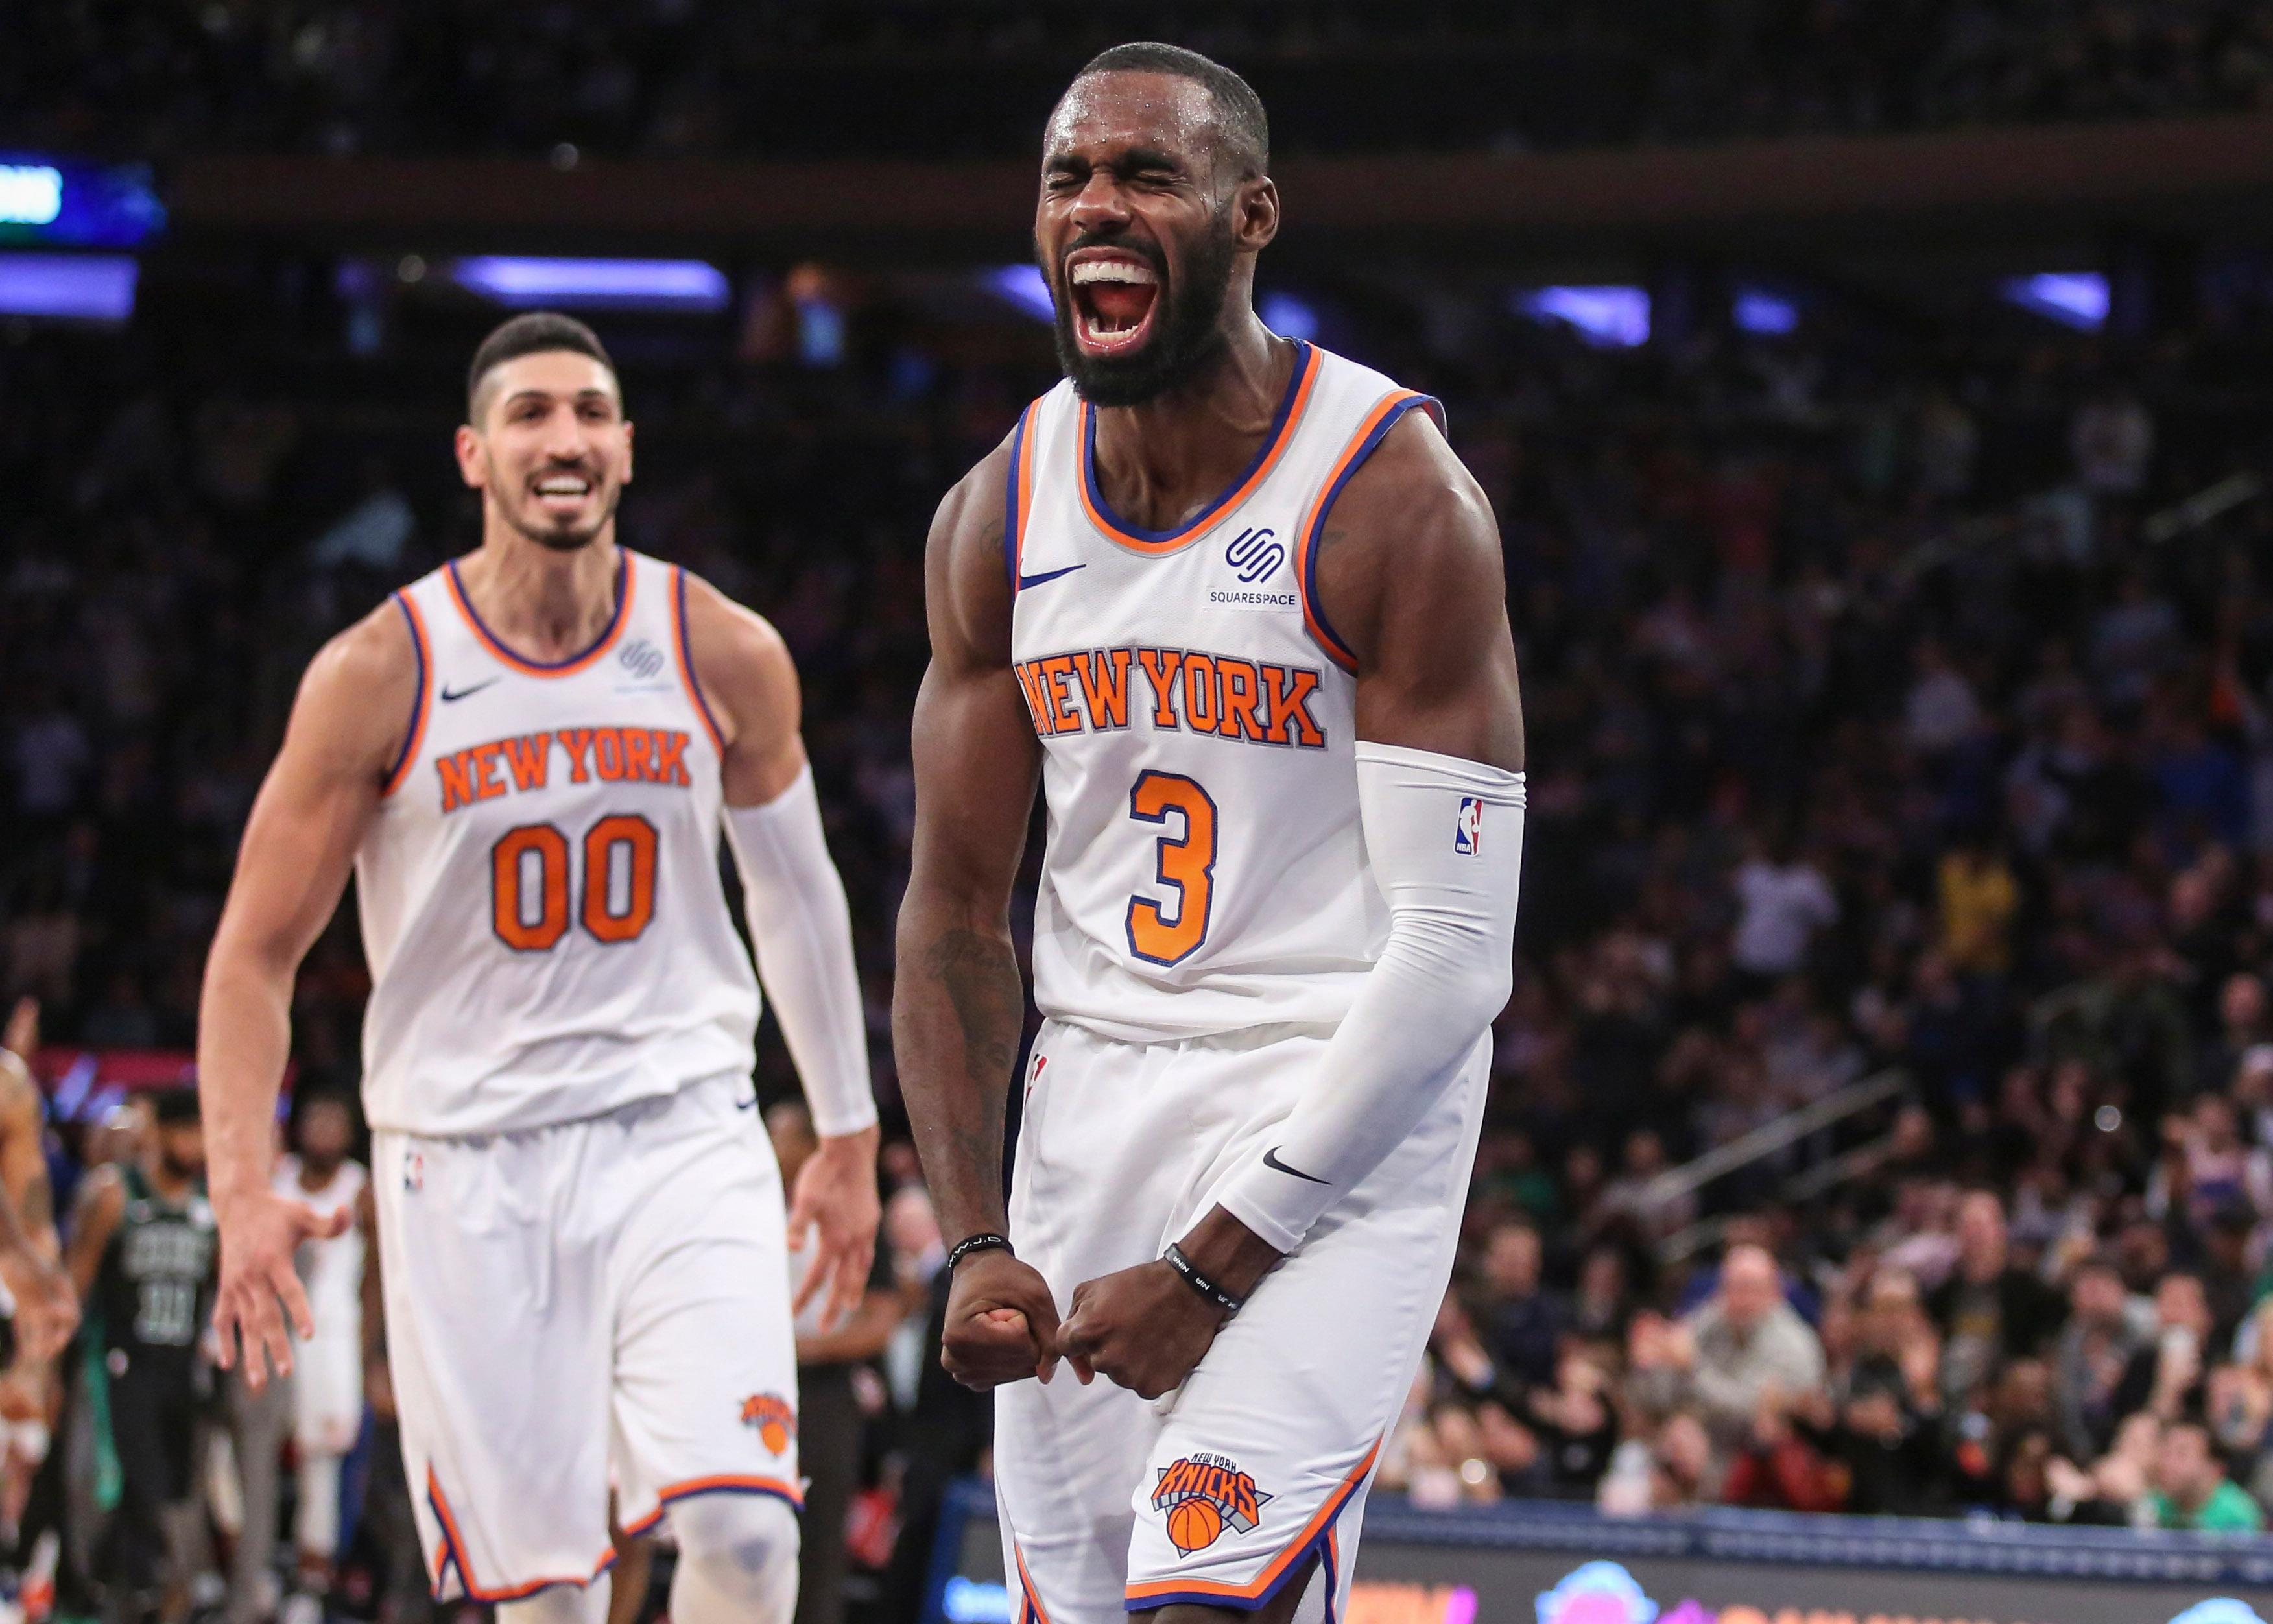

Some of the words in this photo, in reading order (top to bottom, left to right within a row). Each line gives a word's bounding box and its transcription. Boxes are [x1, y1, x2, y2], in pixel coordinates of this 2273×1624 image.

[1210, 591, 1296, 605] SQUARESPACE
[1014, 647, 1136, 737] NEW
[1137, 647, 1329, 751] YORK
[436, 732, 551, 815] NEW
[556, 726, 691, 787] YORK
[1125, 769, 1217, 968] 3
[1457, 842, 1471, 853] NBA
[490, 813, 659, 952] 00
[1172, 1256, 1190, 1273] NINA
[1150, 1457, 1260, 1526] KNICKS
[1191, 1453, 1213, 1463] NEW
[1214, 1455, 1237, 1474] YORK
